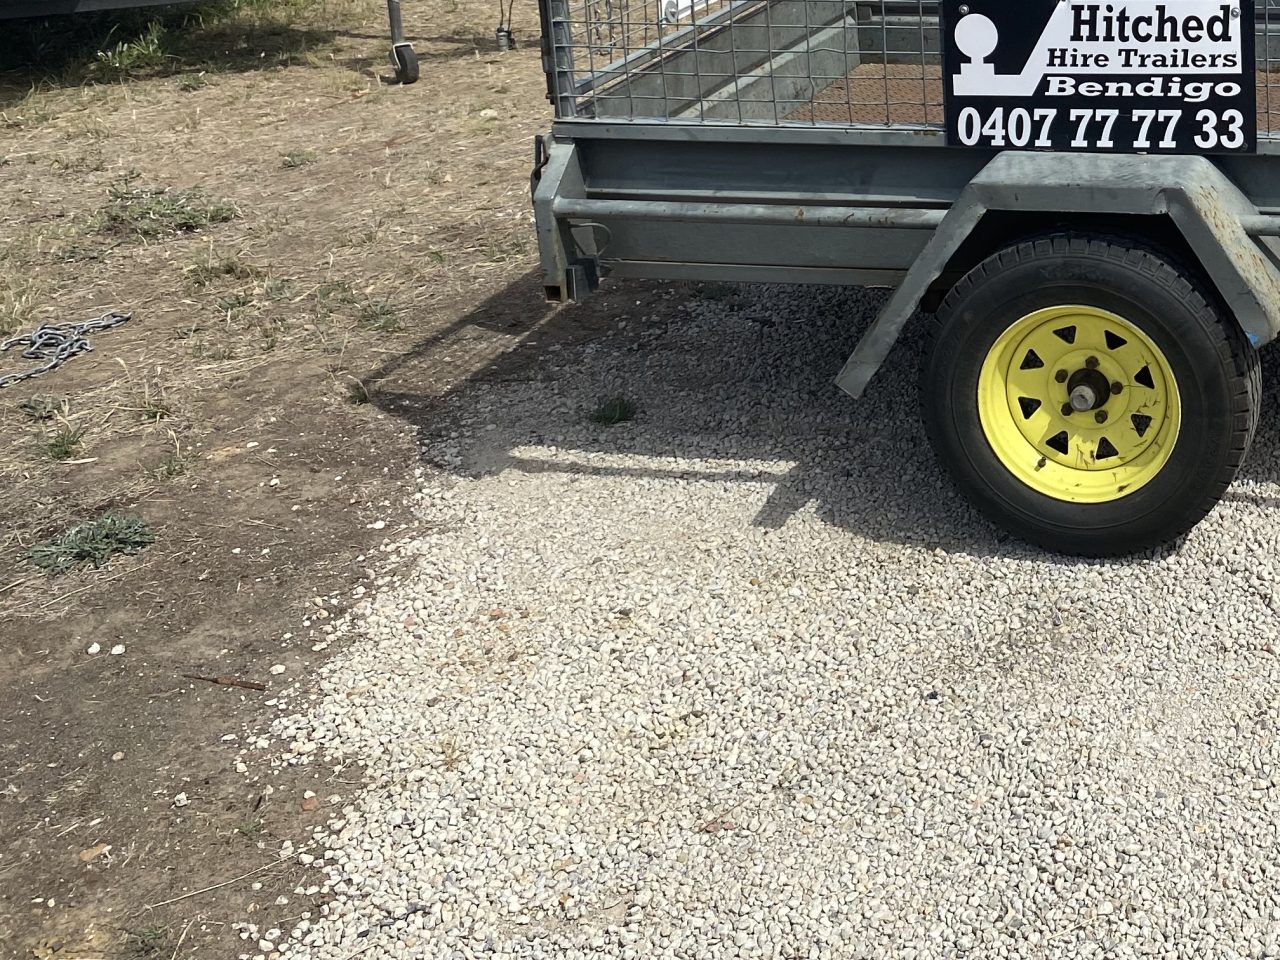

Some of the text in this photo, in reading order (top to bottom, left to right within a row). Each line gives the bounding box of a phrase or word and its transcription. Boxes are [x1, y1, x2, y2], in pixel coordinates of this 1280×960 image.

[1069, 4, 1232, 42] Hitched
[1046, 48, 1238, 68] Hire Trailers
[1045, 76, 1241, 102] Bendigo
[957, 106, 1244, 149] 0407 77 77 33
